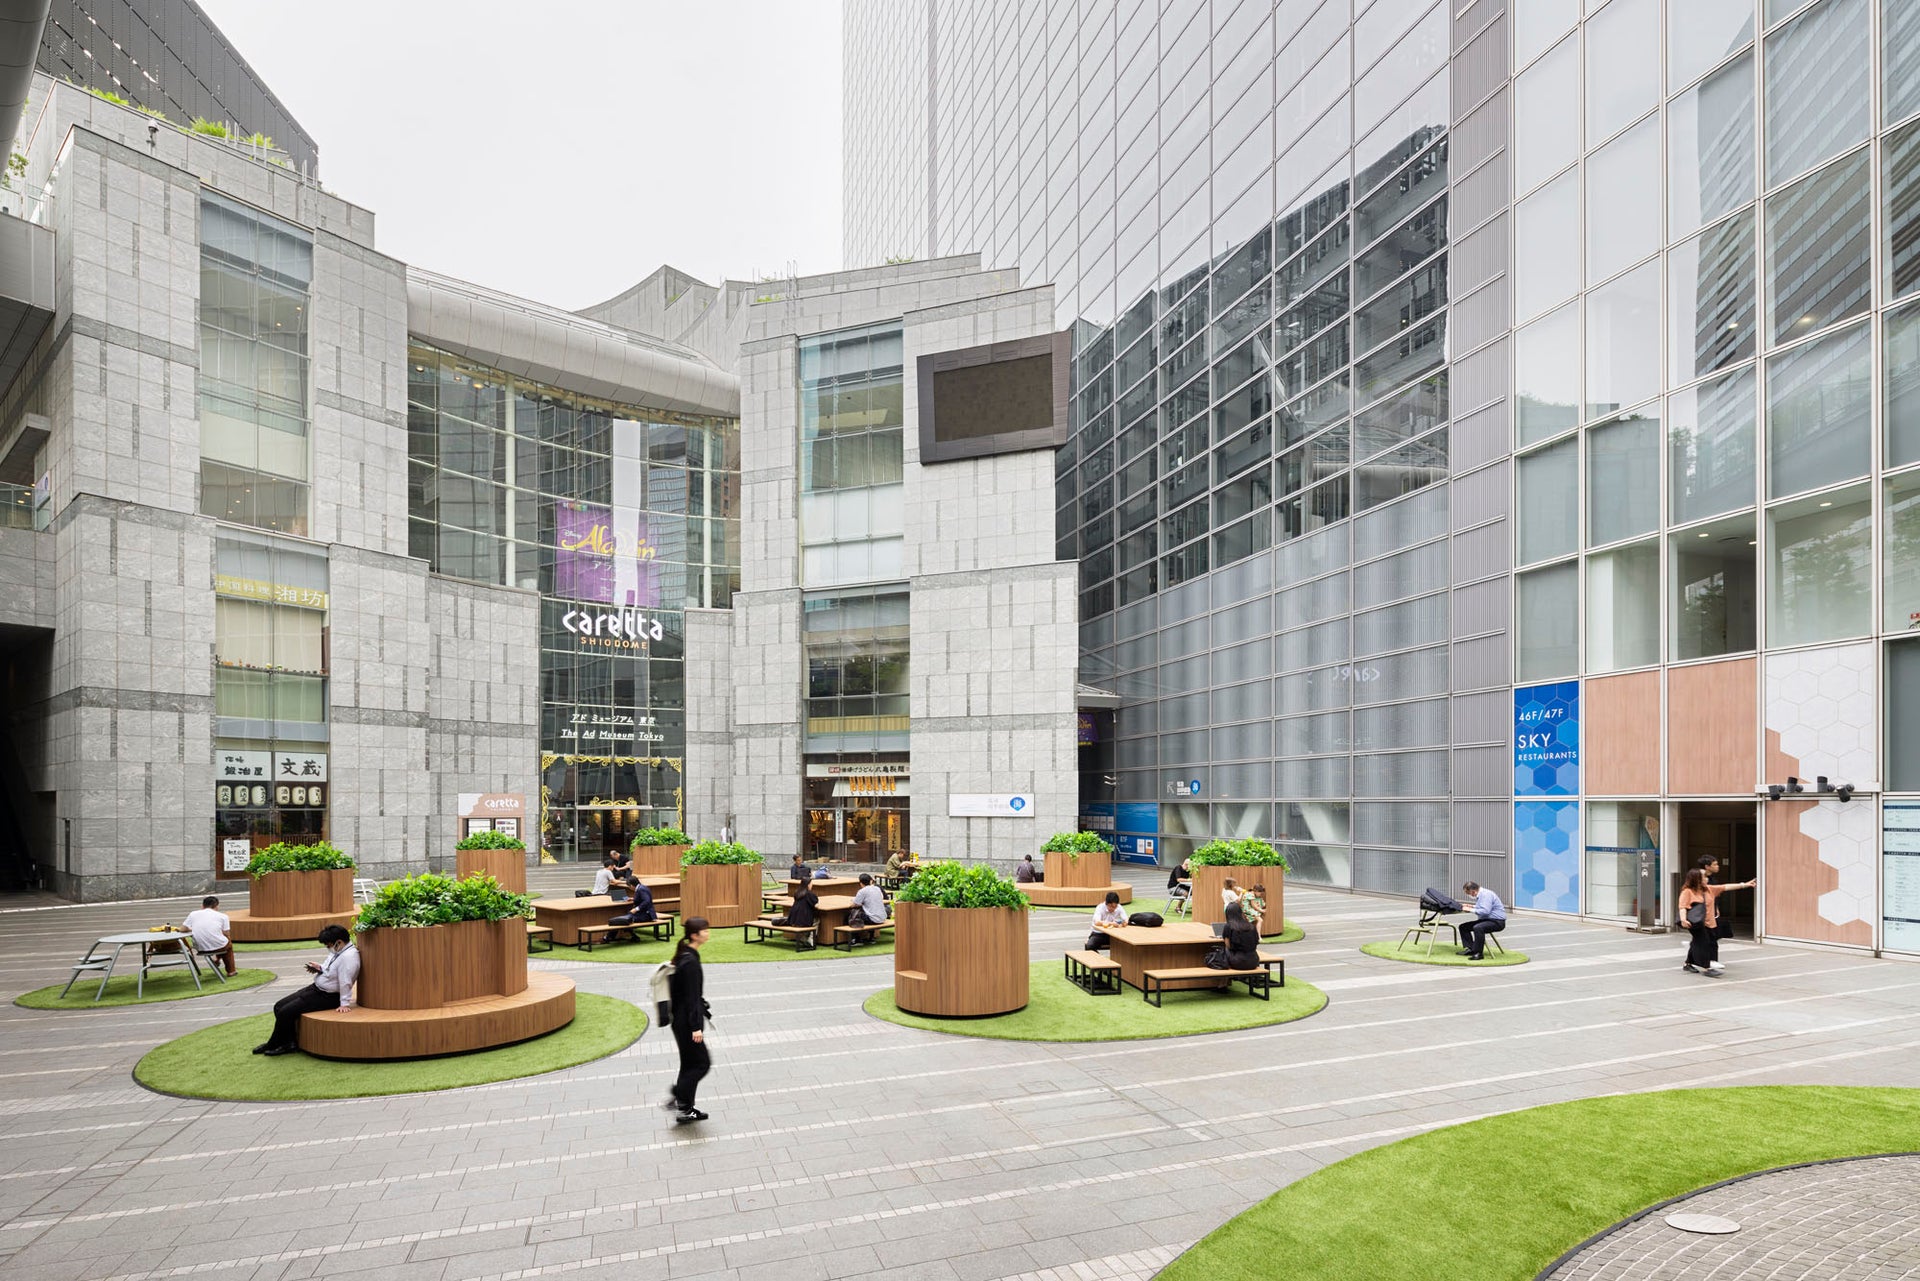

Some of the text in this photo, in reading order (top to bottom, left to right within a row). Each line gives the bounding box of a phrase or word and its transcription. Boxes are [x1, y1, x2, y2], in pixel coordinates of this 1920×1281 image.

[562, 610, 663, 642] caretta
[581, 636, 648, 650] SHIODOME
[1519, 708, 1564, 721] 46F/47F
[561, 729, 664, 741] The Ad Museum Tokyo
[1518, 732, 1551, 749] SKY
[1518, 751, 1577, 761] RESTAURANTS
[280, 757, 322, 777] 文蔵
[484, 798, 520, 808] caretta
